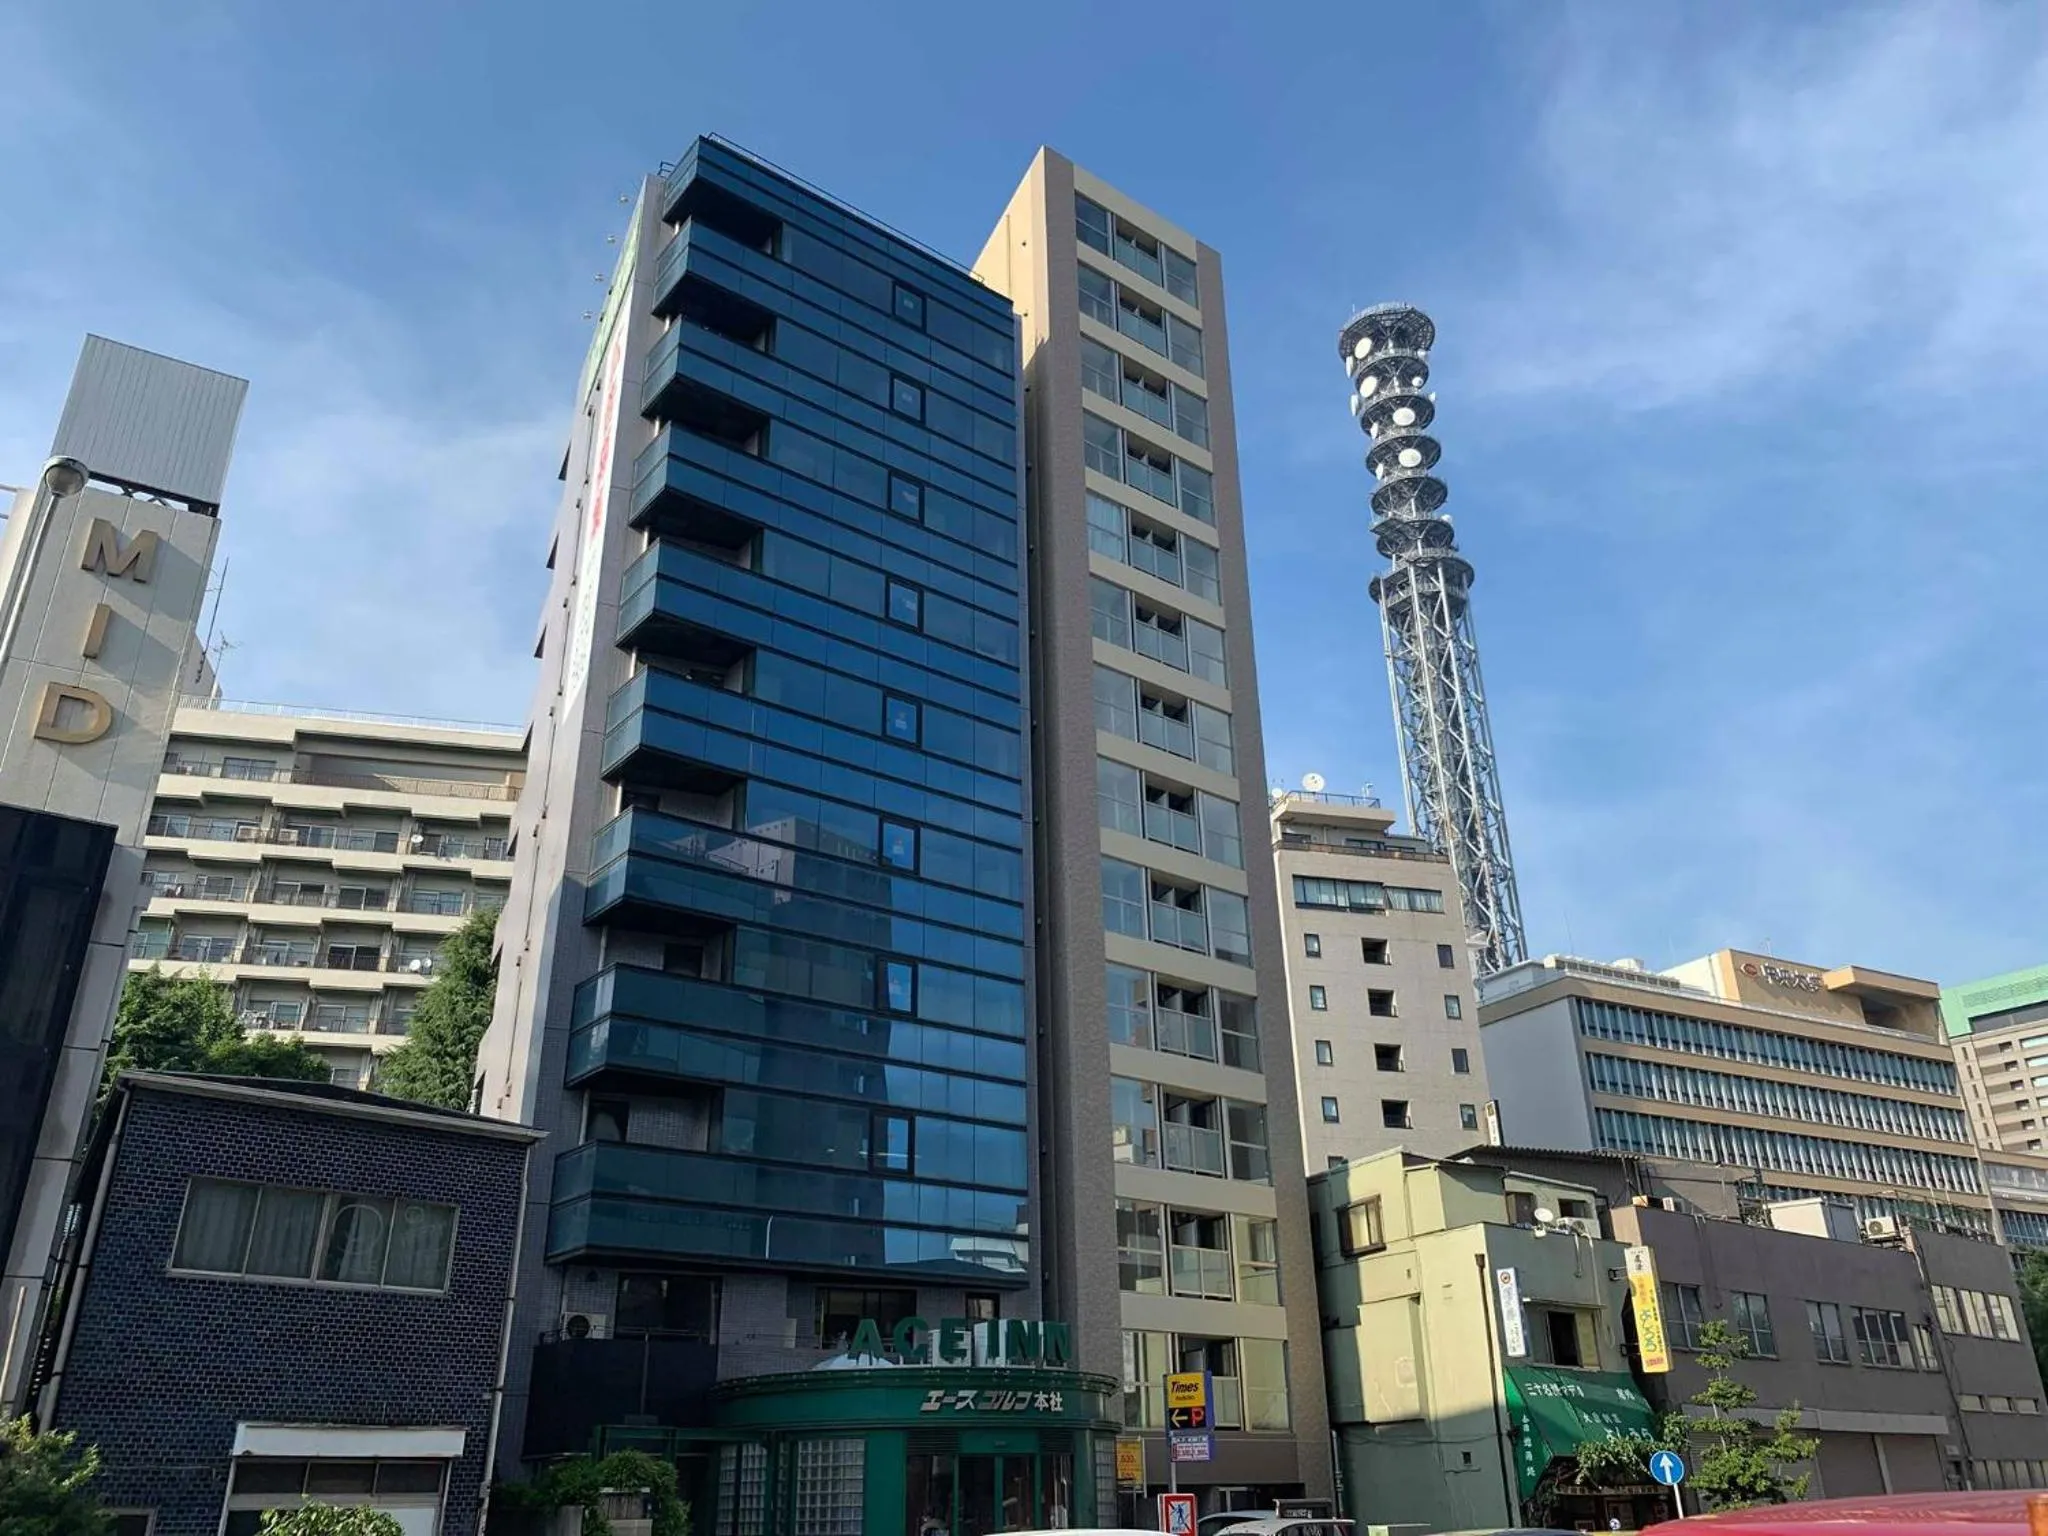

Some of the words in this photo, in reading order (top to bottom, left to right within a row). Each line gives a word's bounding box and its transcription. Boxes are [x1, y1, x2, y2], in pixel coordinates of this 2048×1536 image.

[848, 1316, 968, 1362] ACE
[986, 1319, 1072, 1362] INN
[1171, 1381, 1199, 1393] Times
[1191, 1407, 1204, 1427] P
